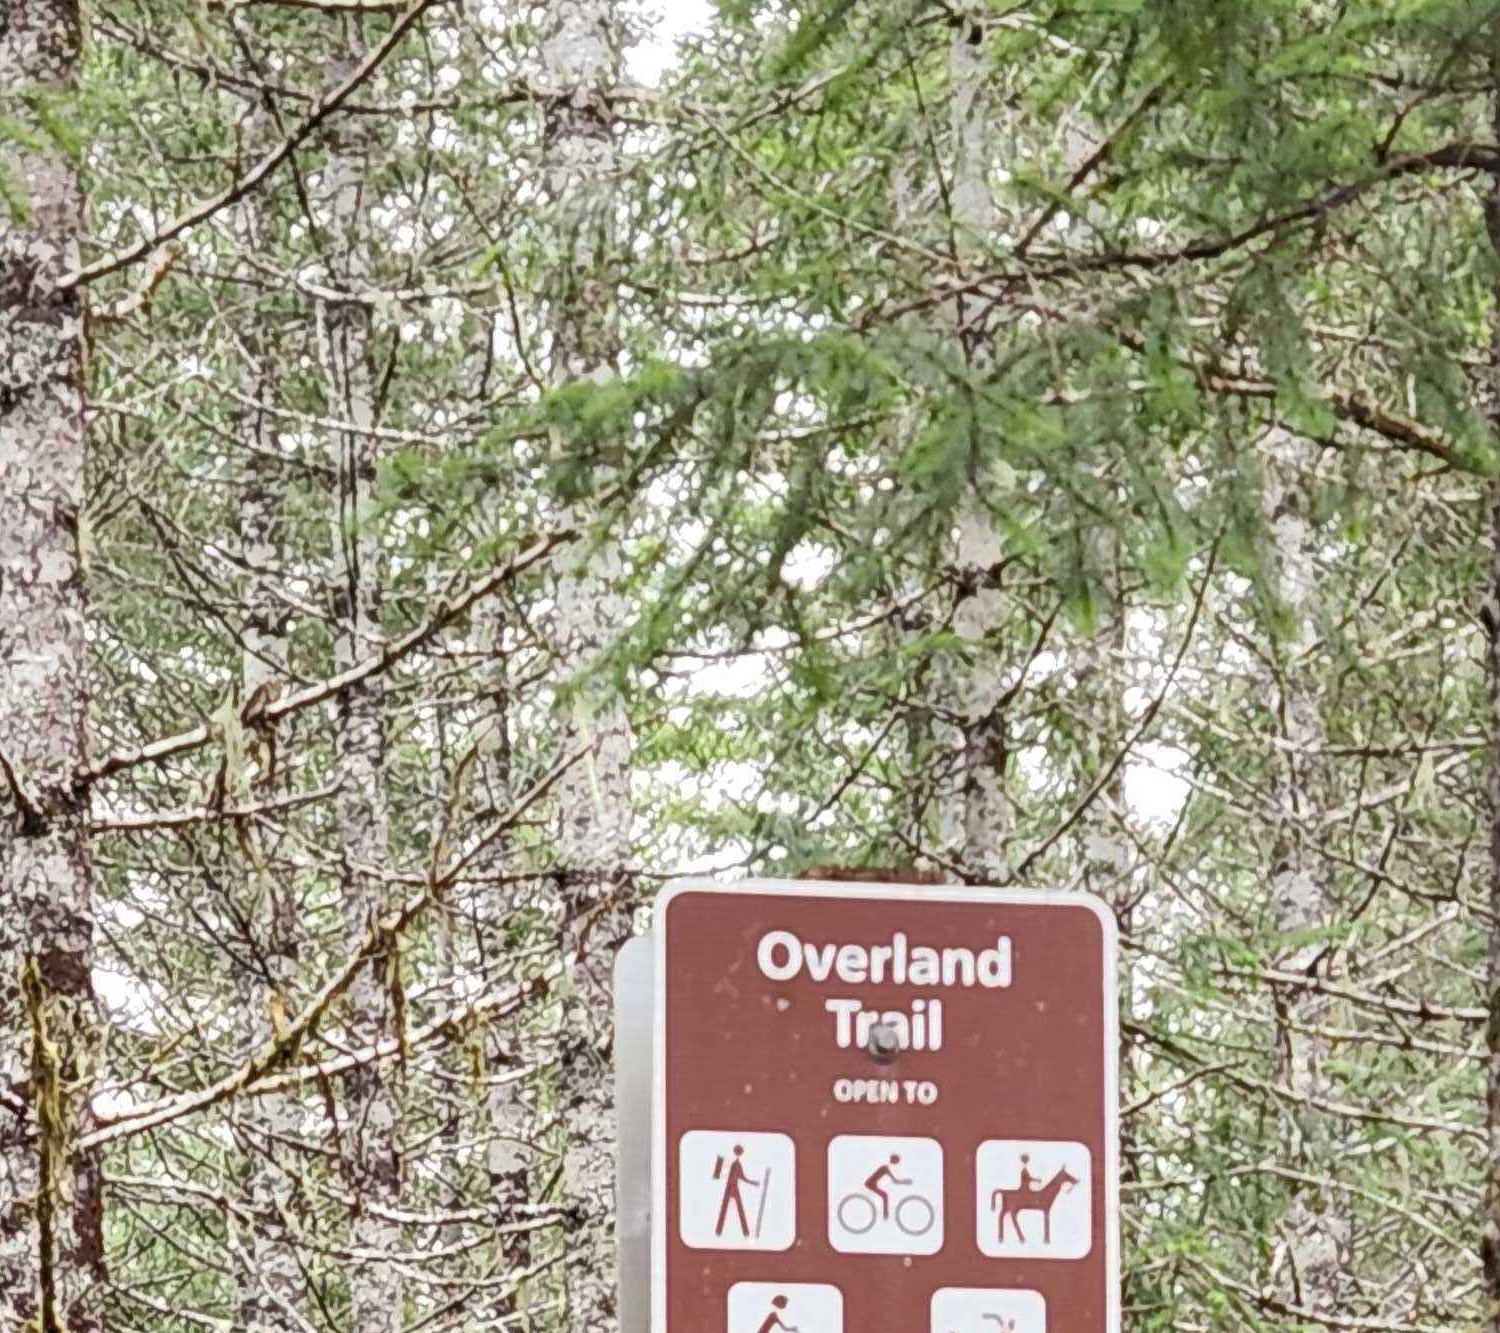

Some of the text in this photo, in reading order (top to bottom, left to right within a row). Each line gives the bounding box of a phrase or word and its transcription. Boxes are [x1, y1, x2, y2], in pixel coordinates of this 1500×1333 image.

[757, 930, 1012, 988] Overland
[825, 998, 942, 1051] Trail
[833, 1078, 938, 1105] OPEN TO
